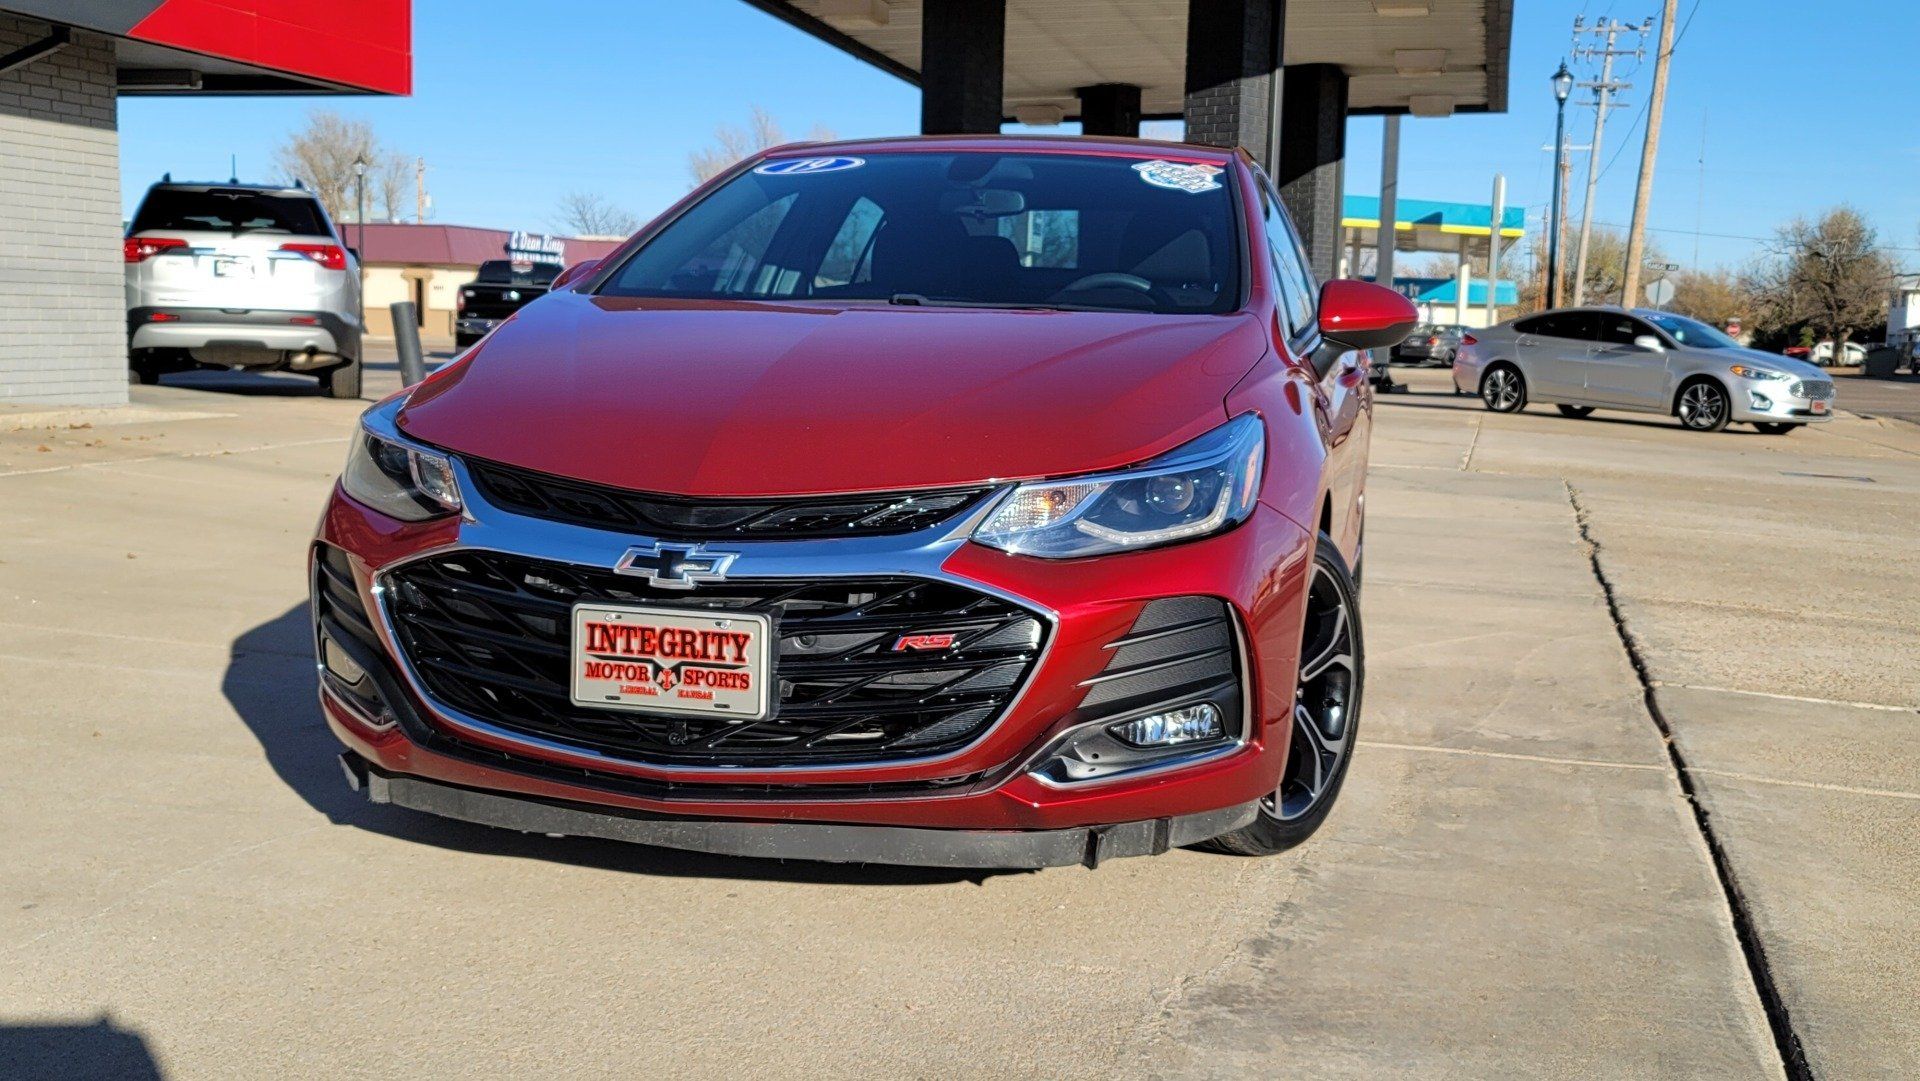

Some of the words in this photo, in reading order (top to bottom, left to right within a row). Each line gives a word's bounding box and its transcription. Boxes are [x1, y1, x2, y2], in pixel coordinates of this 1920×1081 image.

[585, 622, 751, 662] INTEGRITY
[892, 634, 955, 650] RS
[585, 662, 650, 682] MOTOR
[683, 669, 750, 690] SPORTS
